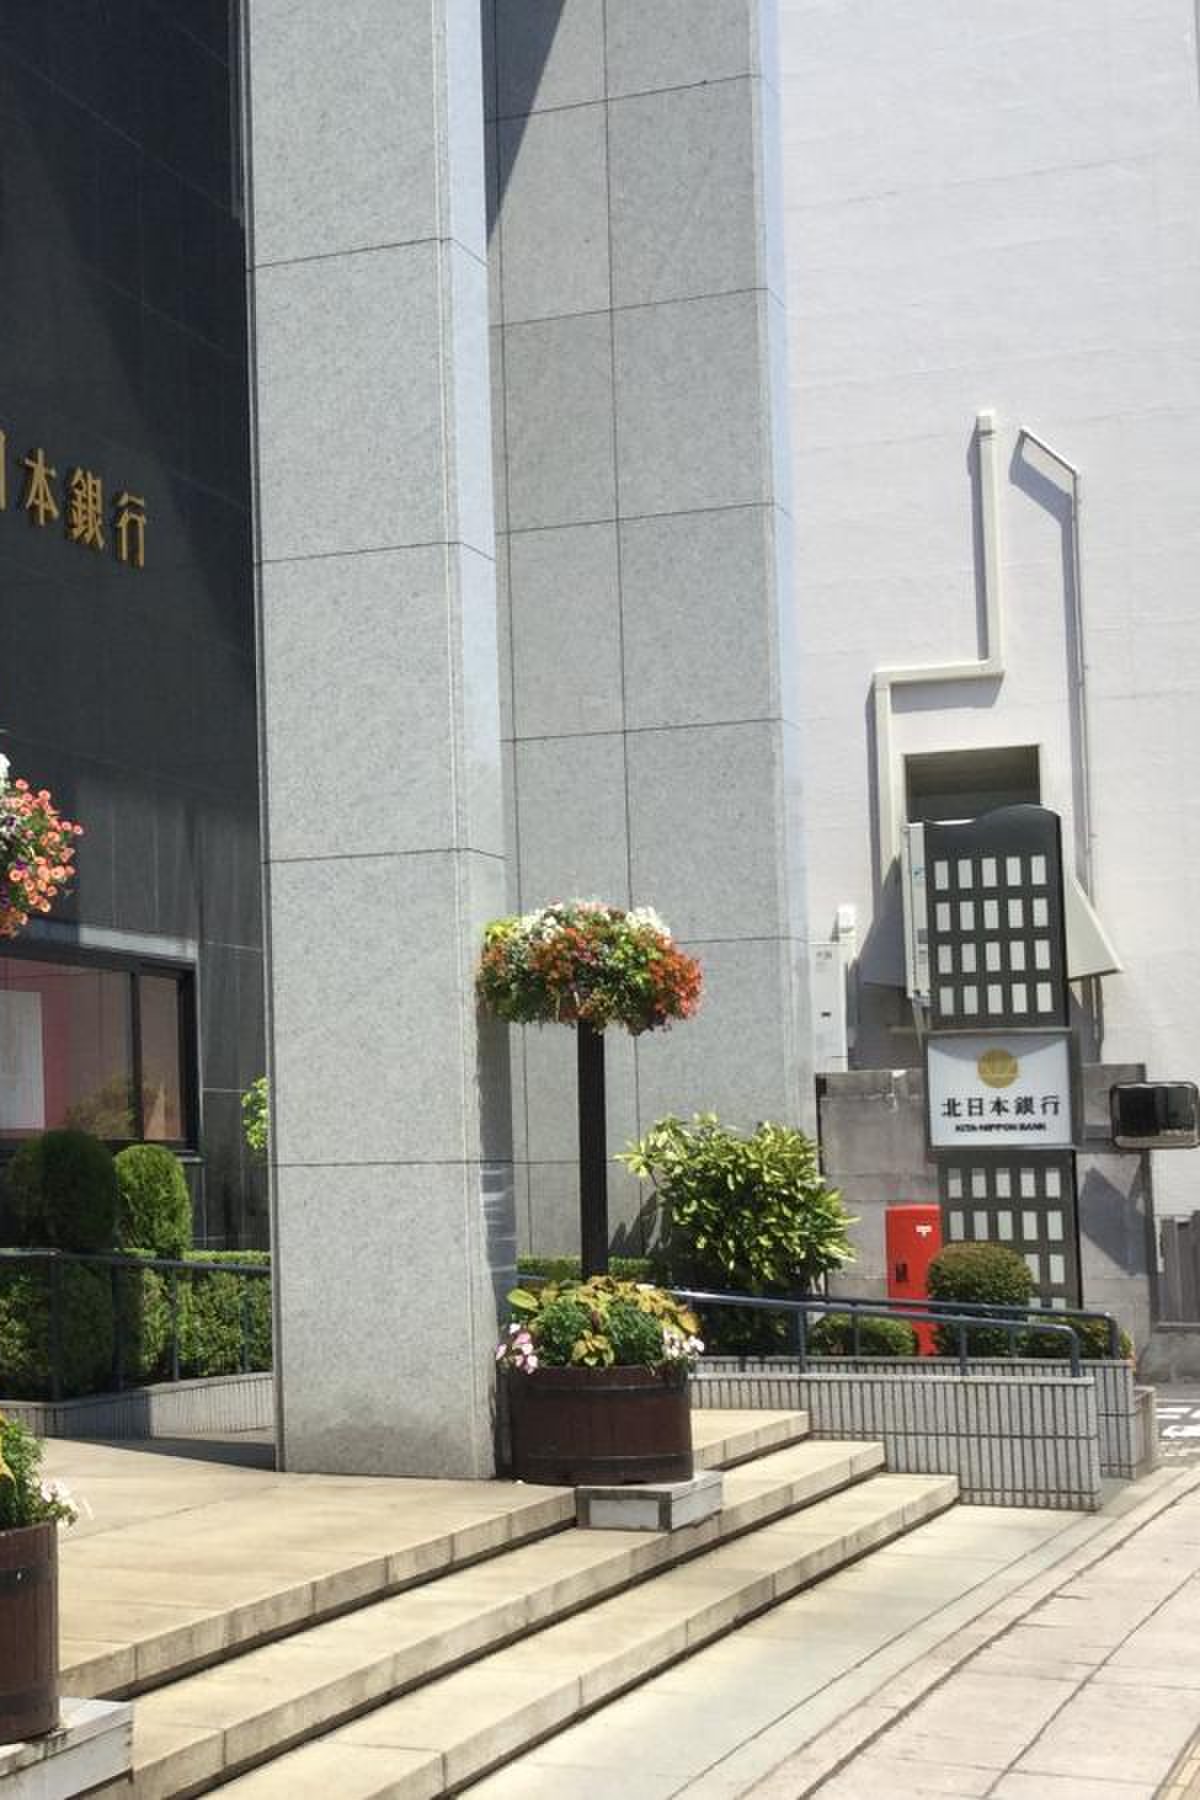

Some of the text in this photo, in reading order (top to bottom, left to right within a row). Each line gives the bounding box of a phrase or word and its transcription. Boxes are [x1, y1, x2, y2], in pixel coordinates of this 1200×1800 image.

[941, 1095, 1060, 1117] 北日本銀行
